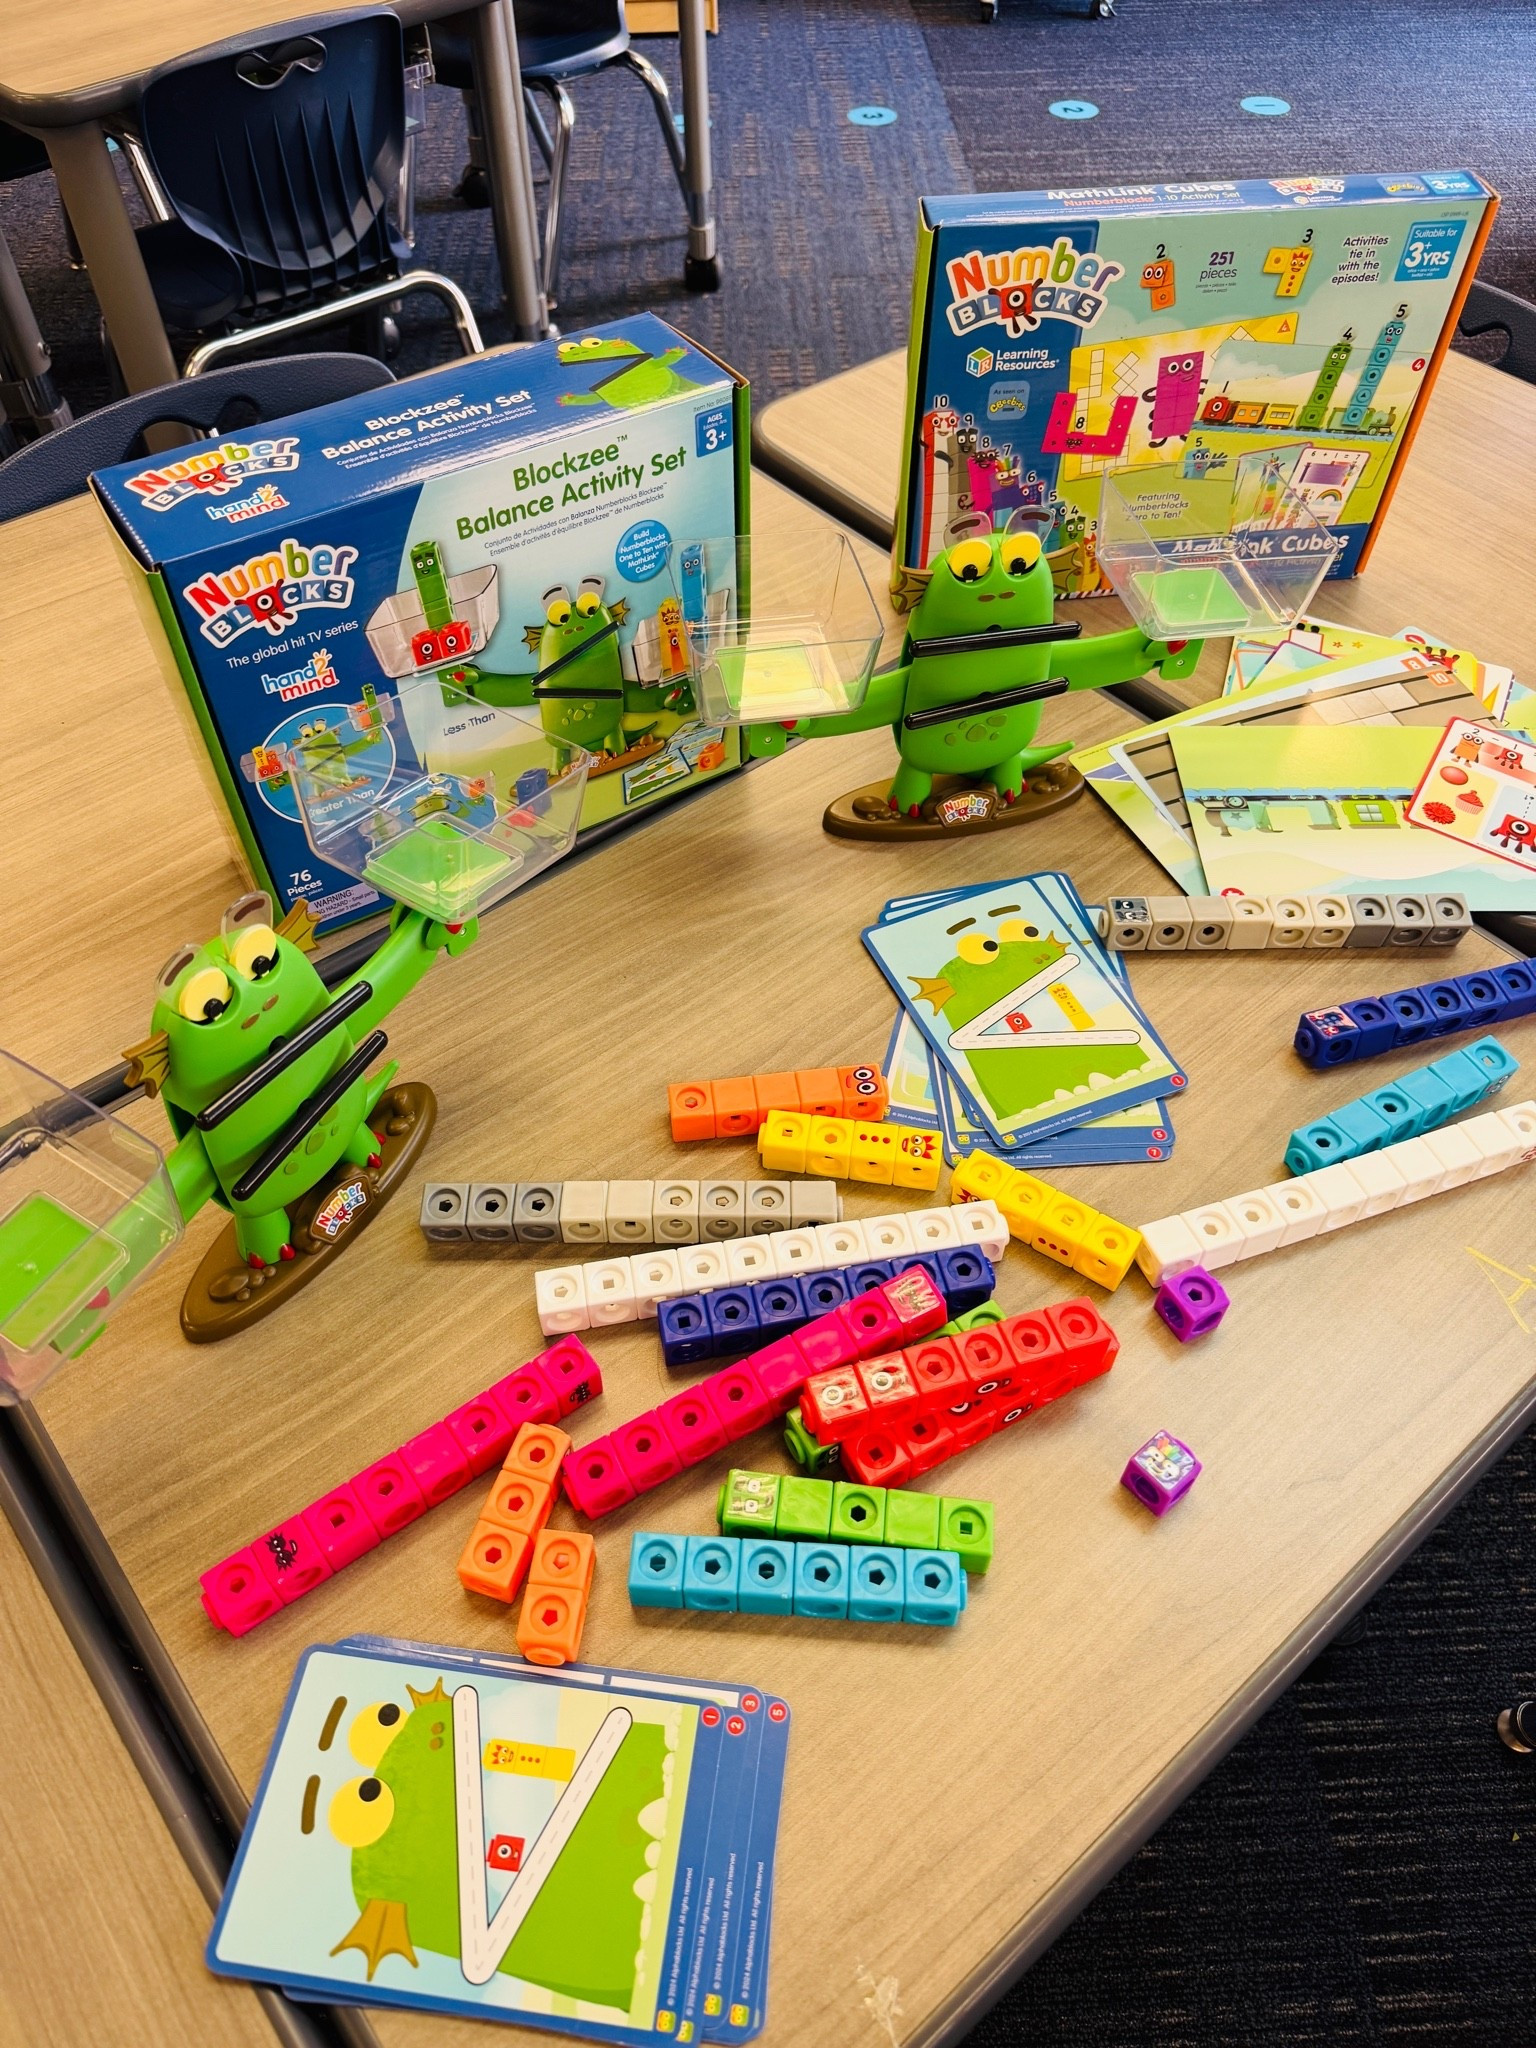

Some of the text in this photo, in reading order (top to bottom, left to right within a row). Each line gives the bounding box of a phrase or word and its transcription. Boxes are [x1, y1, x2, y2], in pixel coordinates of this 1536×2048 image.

[1047, 183, 1236, 200] MathLink Cubes
[1063, 191, 1240, 207] Numberblocks 1-10 Activity Set
[1302, 228, 1314, 243] 3
[1414, 227, 1458, 238] Suitable for
[1343, 235, 1389, 247] Activities
[1156, 243, 1166, 259] 2
[1349, 248, 1376, 258] tie in
[1208, 251, 1235, 266] 251
[951, 242, 1120, 298] Number
[1338, 261, 1380, 272] with the
[1199, 268, 1238, 282] pieces
[1331, 272, 1380, 286] episodes!
[1395, 304, 1408, 318] 5
[1343, 327, 1353, 340] 4
[996, 348, 1049, 360] Learning
[1413, 359, 1423, 370] 4
[934, 395, 949, 408] 10
[321, 389, 532, 459] Balance Activity Set
[707, 412, 723, 424] AGES
[964, 415, 973, 426] 9
[1075, 416, 1085, 429] 8
[336, 454, 368, 466] Conjunto
[379, 440, 417, 453] Actividades
[431, 426, 458, 438] Balanza
[458, 413, 505, 429] Numberblocks
[345, 456, 379, 469] Ensemble
[491, 409, 537, 425] Numberblocks
[982, 437, 991, 448] 8
[1195, 437, 1203, 447] 5
[1003, 444, 1012, 457] 7
[129, 439, 295, 495] Number
[1027, 472, 1036, 483] 6
[456, 446, 687, 541] Balance Activity Set
[1049, 491, 1058, 502] 5
[1137, 493, 1181, 502] Featuring
[1070, 506, 1080, 516] 4
[1163, 511, 1182, 519] Ten!
[484, 535, 513, 549] Conjunto
[513, 532, 522, 540] de
[523, 519, 558, 536] Actividades
[558, 516, 570, 524] con
[570, 508, 595, 521] Balanza
[595, 492, 638, 512] Numberblocks
[489, 539, 521, 557] Ensemble
[614, 506, 623, 515] de
[623, 493, 665, 512] Numberblocks
[1090, 521, 1098, 531] 3
[633, 529, 650, 541] Build
[620, 533, 666, 554] Numberblocks
[1281, 534, 1350, 552] Cubes
[619, 554, 633, 563] One
[642, 546, 654, 555] Ten
[654, 540, 669, 550] with
[635, 563, 656, 574] Cubes
[188, 543, 354, 617] Number
[226, 620, 359, 669] The global hit TV series
[1432, 673, 1449, 683] 10
[443, 712, 496, 737] Less Than
[944, 795, 989, 813] Number
[289, 869, 312, 885] 76
[287, 880, 323, 896] Pieces
[314, 889, 355, 908] WARNING:
[325, 900, 348, 911] HAZARD
[317, 1183, 361, 1227] Number
[772, 1708, 783, 1716] 5
[730, 1721, 742, 1730] 2
